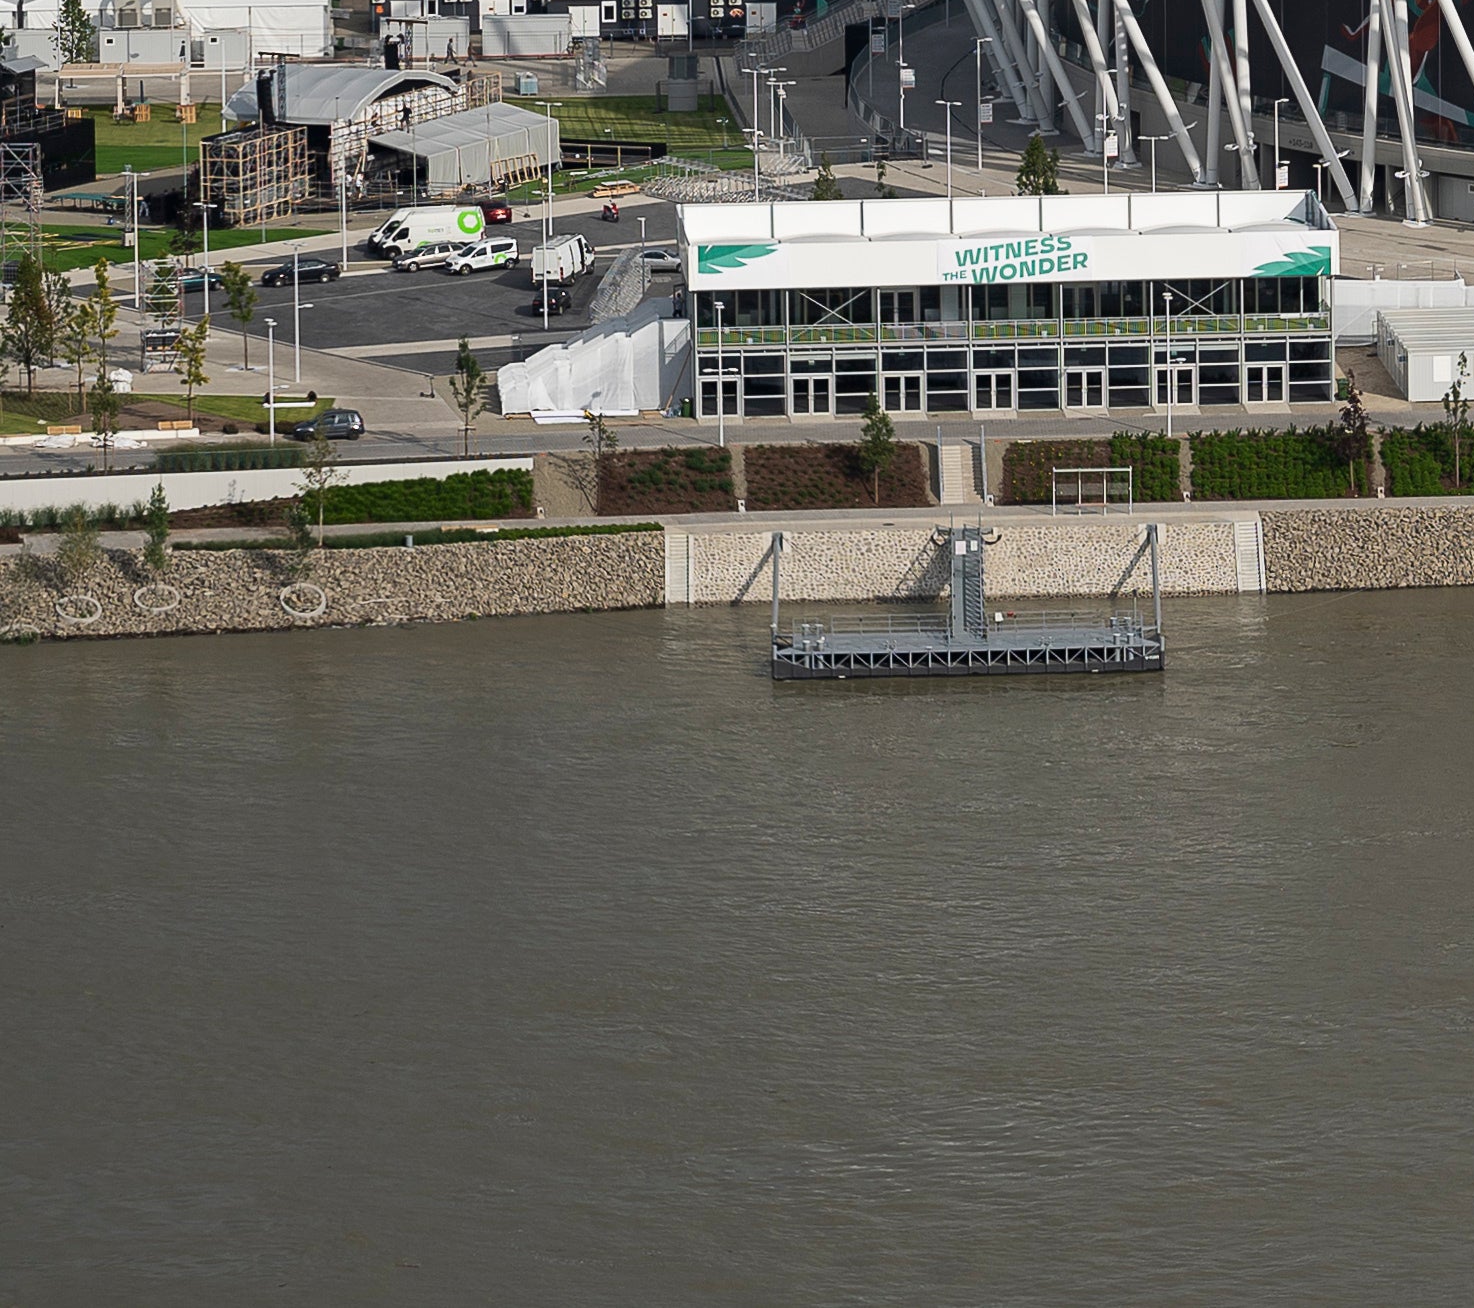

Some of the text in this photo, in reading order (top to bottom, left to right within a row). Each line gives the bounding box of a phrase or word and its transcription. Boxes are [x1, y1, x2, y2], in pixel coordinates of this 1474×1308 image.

[955, 235, 1072, 267] WITNESS
[942, 252, 1088, 284] THE WONDER
